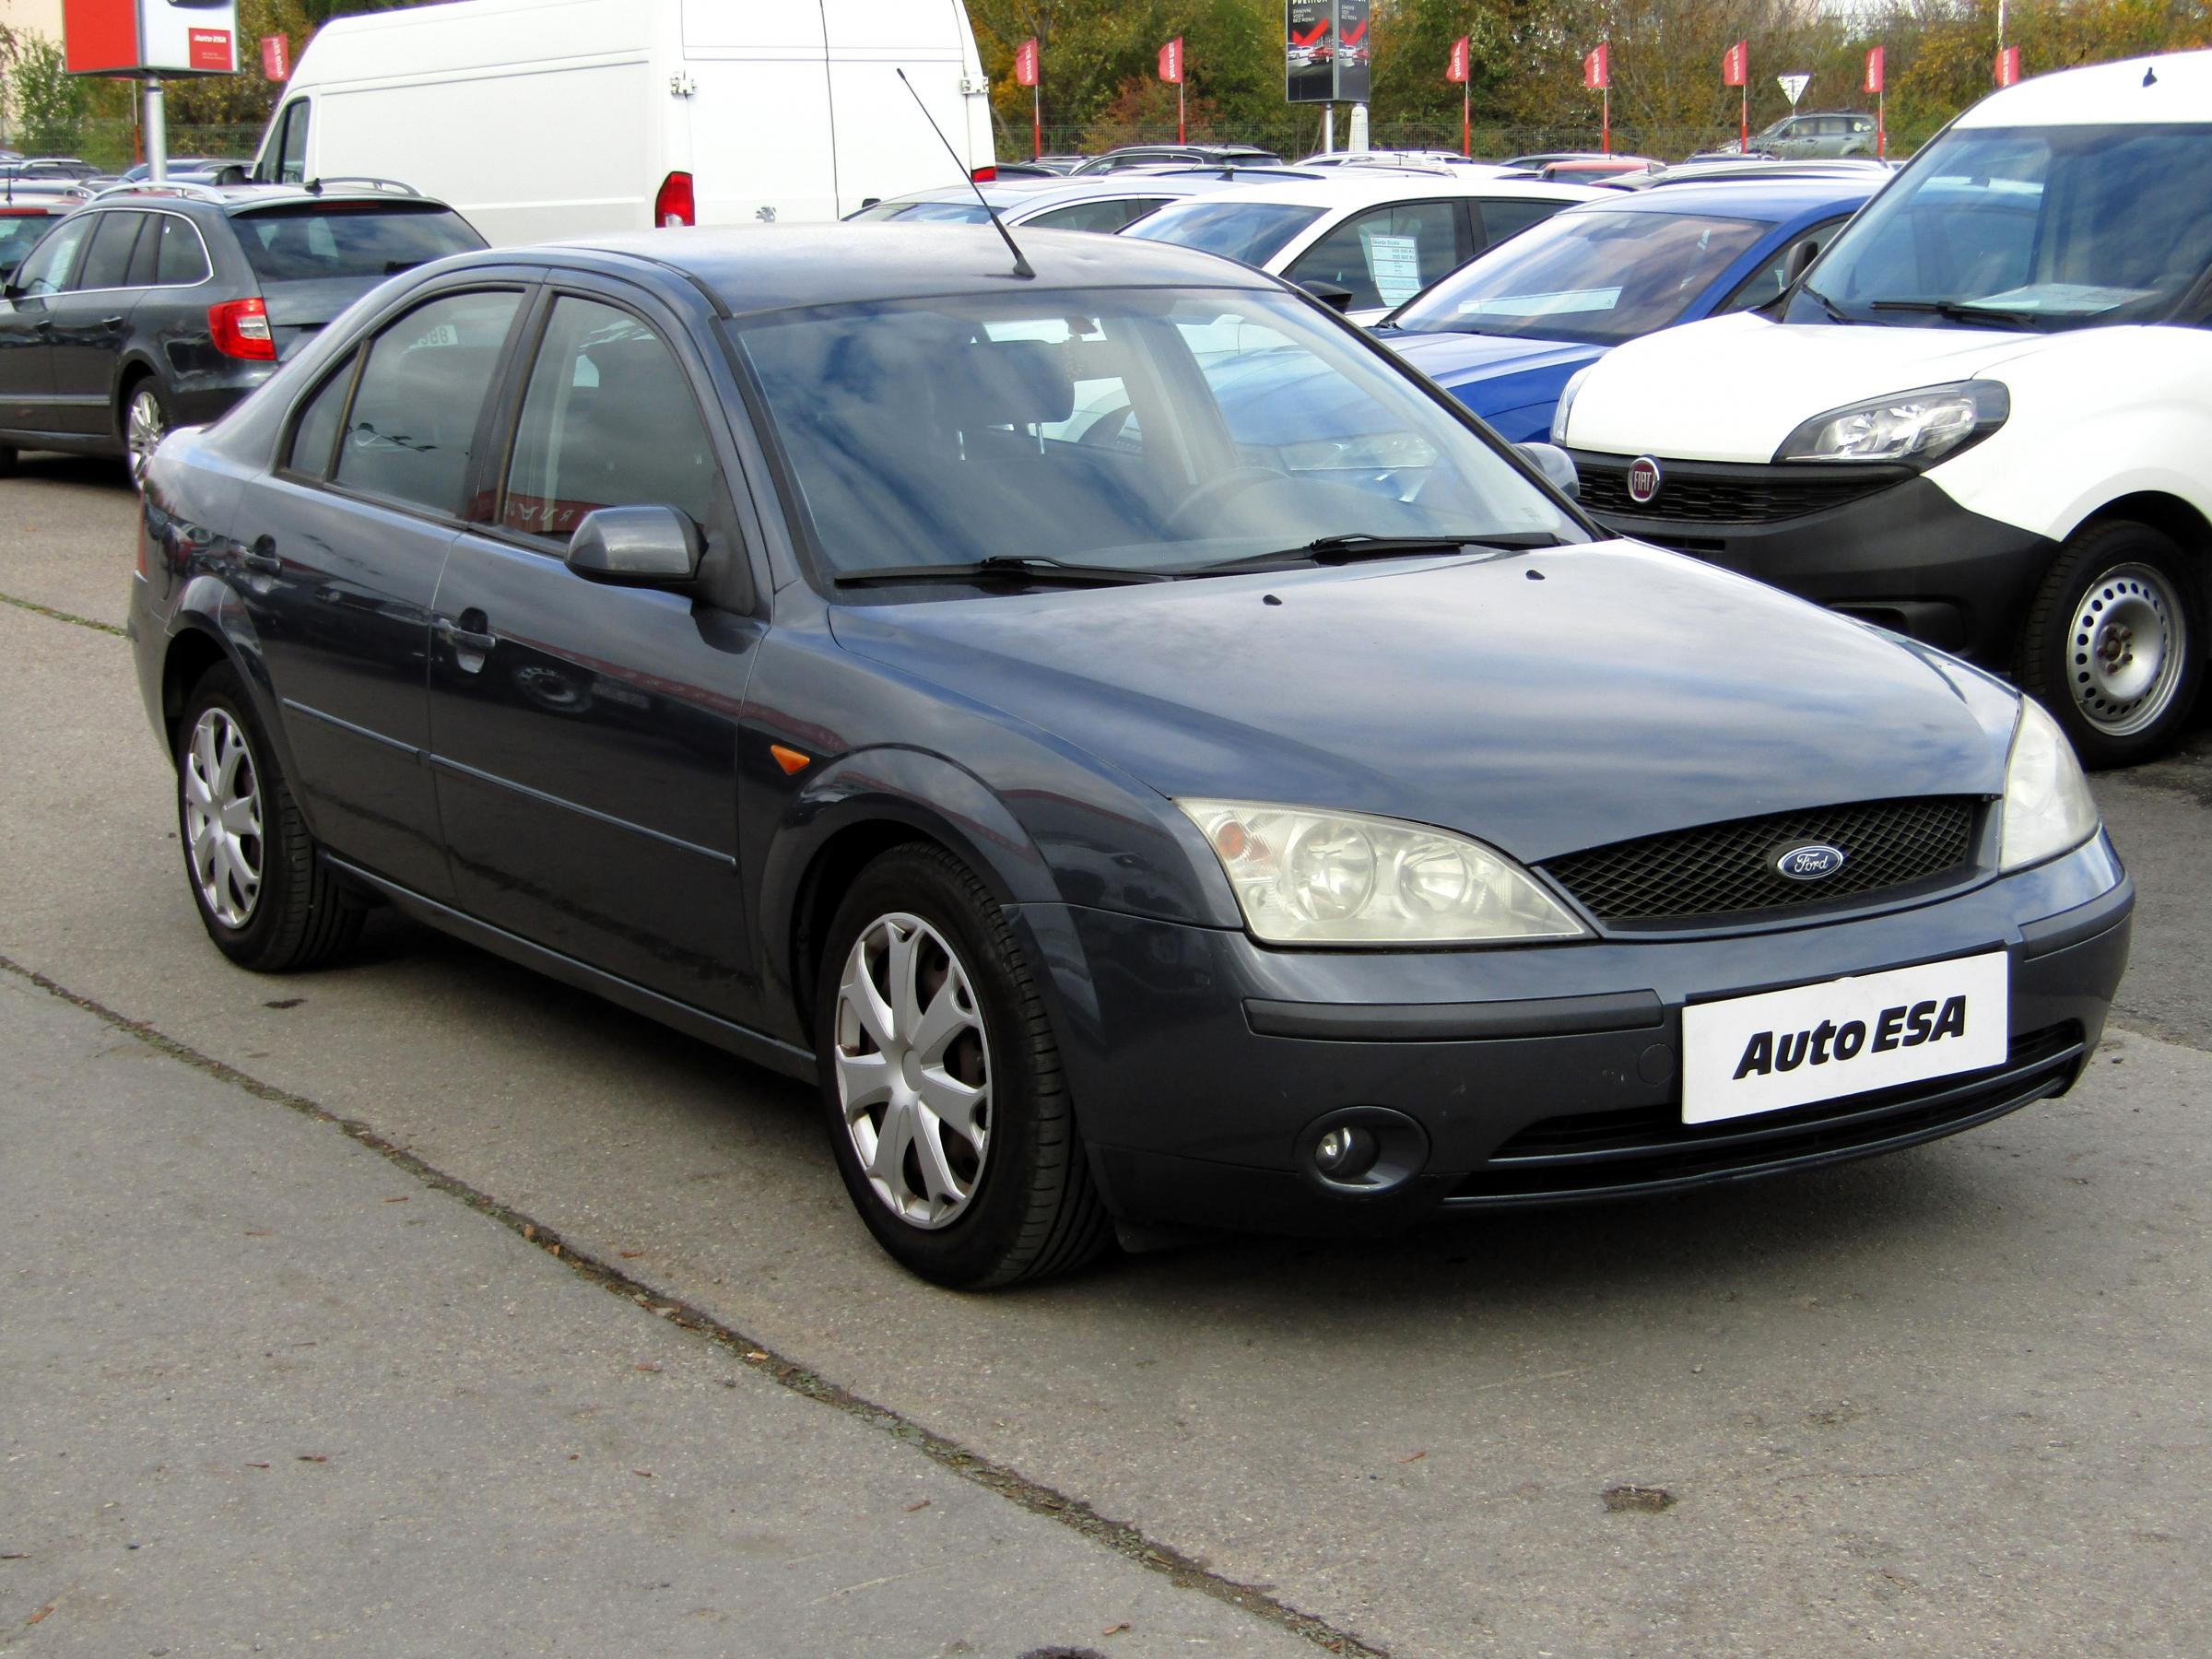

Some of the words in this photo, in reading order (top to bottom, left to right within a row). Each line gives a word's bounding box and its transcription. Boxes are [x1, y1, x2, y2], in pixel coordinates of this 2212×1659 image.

[1633, 470, 1653, 491] FIAT
[1794, 853, 1829, 873] Ford
[1733, 1018, 1866, 1080] Auto
[1871, 994, 1966, 1053] ESA
